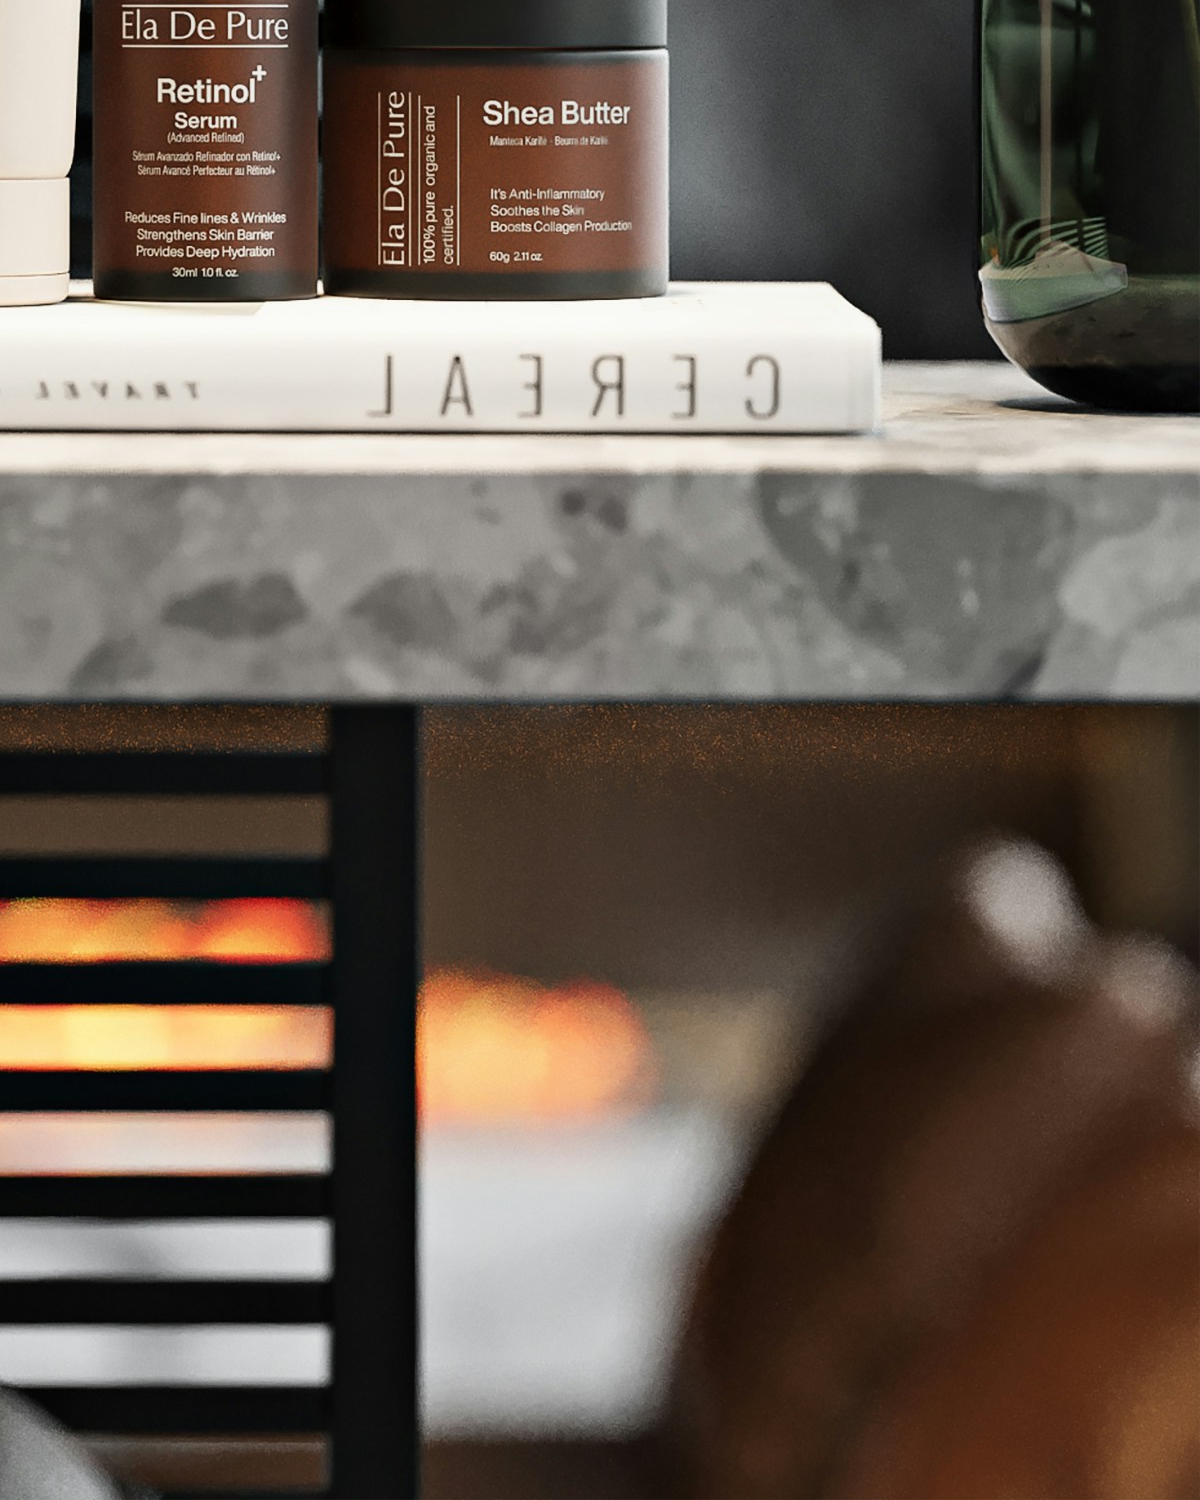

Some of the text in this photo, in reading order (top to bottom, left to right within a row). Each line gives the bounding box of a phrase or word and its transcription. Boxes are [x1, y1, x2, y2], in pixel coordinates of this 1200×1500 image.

[122, 8, 289, 40] Ela De Pure
[483, 100, 631, 125] Shea Butter
[174, 111, 238, 129] Serum
[167, 132, 245, 144] (Advanced Refined)
[156, 151, 194, 162] Avanzado
[195, 151, 234, 162] Refinador
[236, 153, 251, 162] con
[162, 165, 191, 176] Avancé
[192, 165, 233, 176] Perfecteur
[234, 167, 245, 176] au
[381, 91, 405, 266] Ela De Pure
[423, 105, 439, 264] 100% pure organic and
[490, 188, 605, 201] It's Anti-Inflammatory
[490, 204, 585, 216] Soothes the Skin
[125, 211, 287, 224] Reduces Fine lines & Wrinkles
[490, 219, 633, 235] Boosts Collagen Production
[137, 228, 274, 242] Strengthens Skin Barrier
[441, 204, 454, 265] certified.
[136, 245, 275, 260] Provides Deep Hydration
[489, 251, 510, 263] 60g
[172, 267, 198, 278] 30ml
